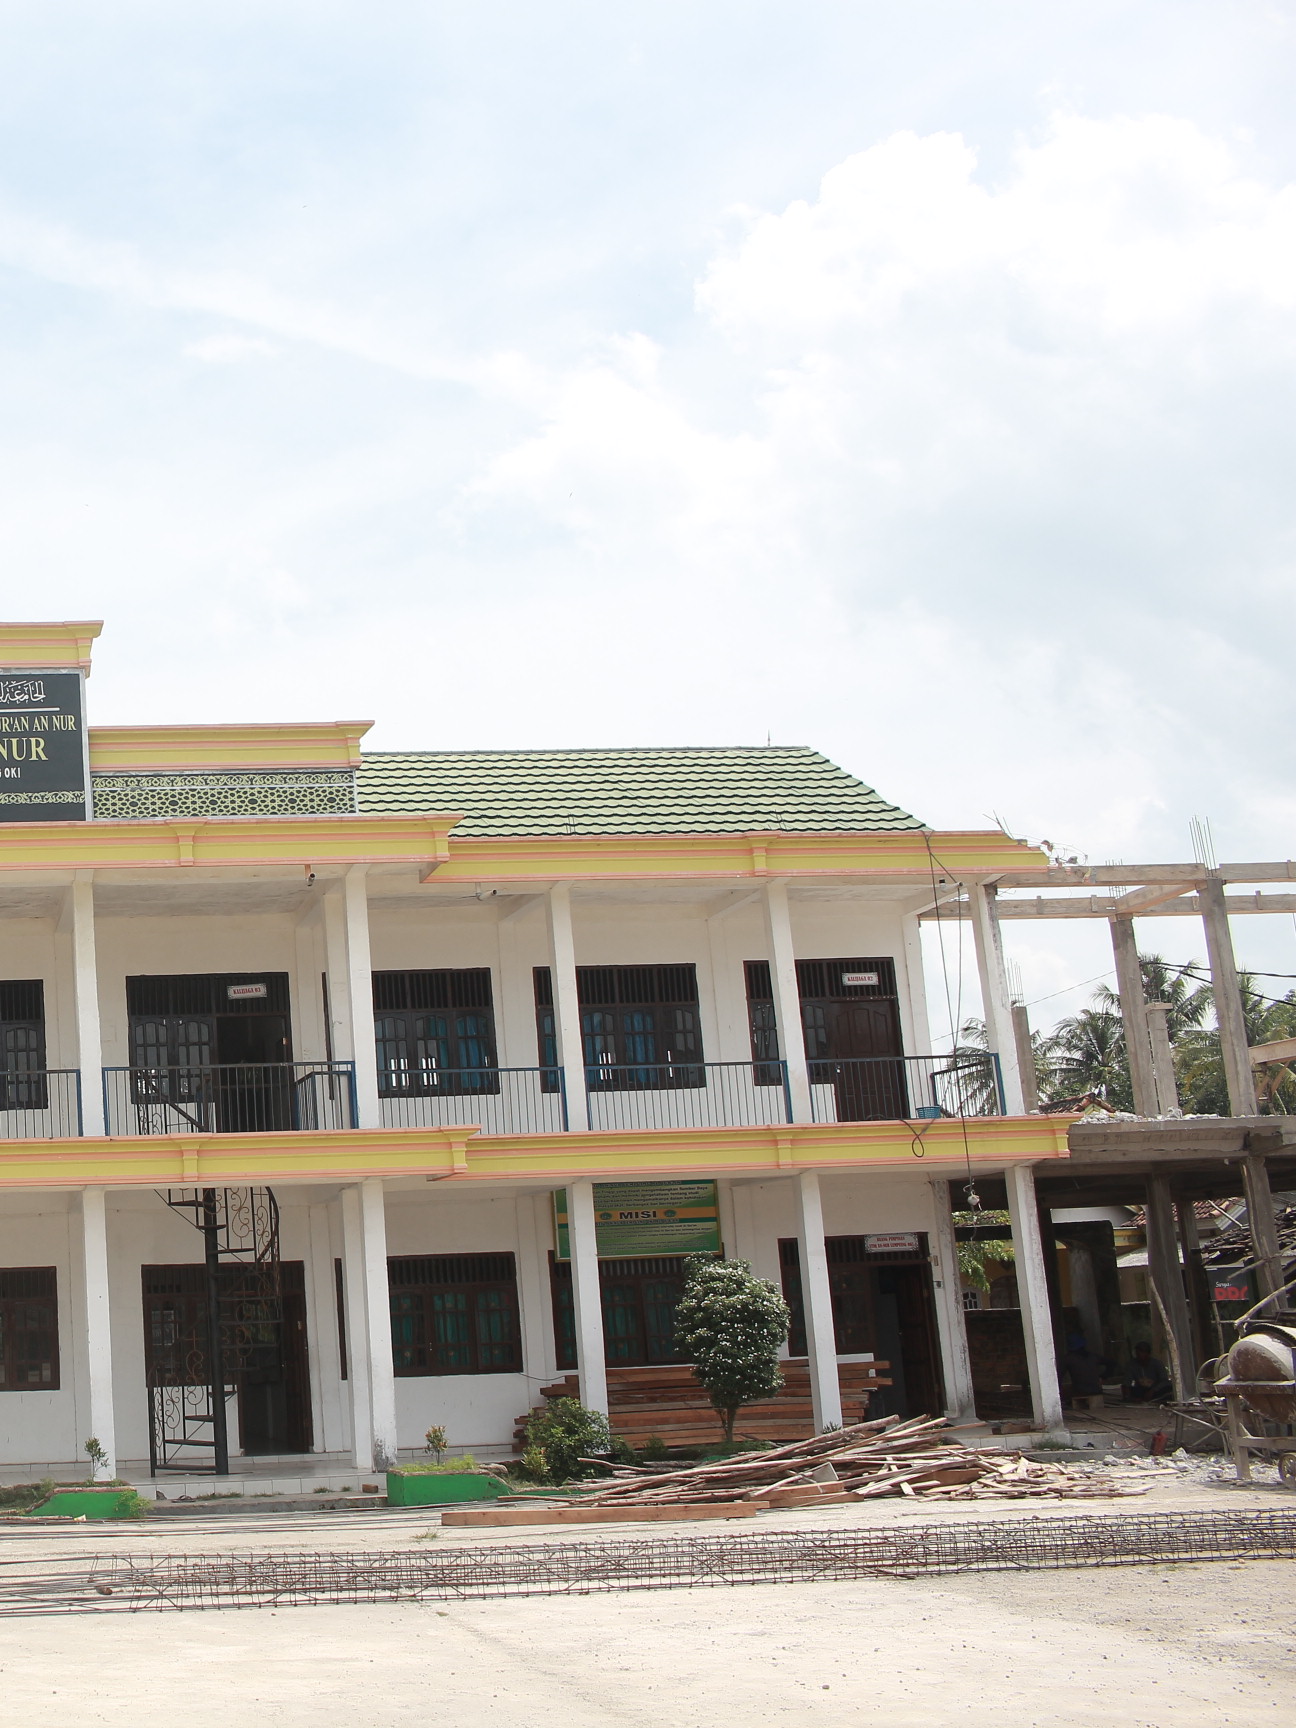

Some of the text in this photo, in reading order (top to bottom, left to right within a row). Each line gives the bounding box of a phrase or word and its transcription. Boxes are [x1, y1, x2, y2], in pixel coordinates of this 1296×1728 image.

[33, 715, 49, 732] AN
[53, 714, 77, 732] NUR
[619, 1210, 657, 1219] MISI
